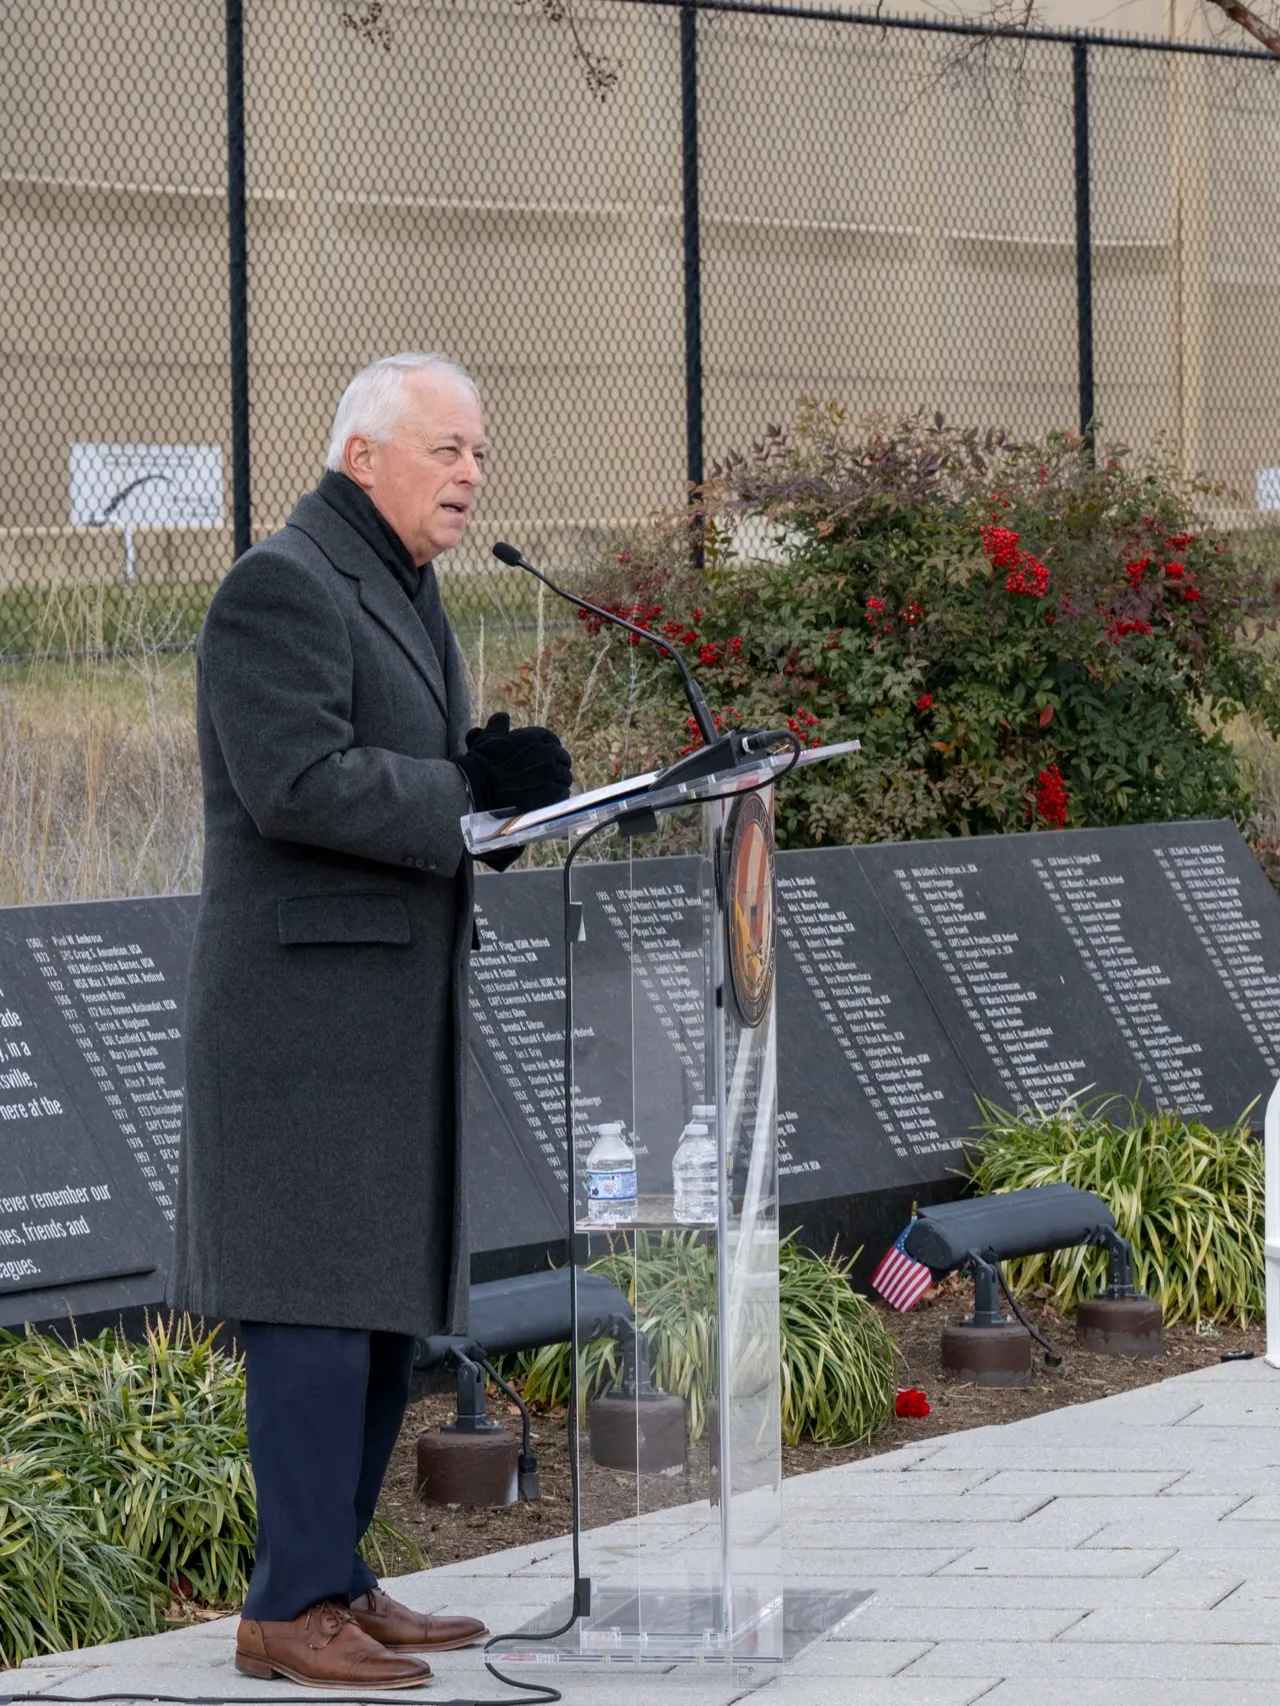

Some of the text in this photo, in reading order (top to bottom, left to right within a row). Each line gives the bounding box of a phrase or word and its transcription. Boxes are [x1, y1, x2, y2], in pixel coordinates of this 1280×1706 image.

[5, 1039, 22, 1059] in
[21, 1041, 31, 1056] a
[28, 1098, 43, 1117] at
[40, 1097, 63, 1115] the
[30, 1184, 89, 1209] remember
[90, 1184, 111, 1201] our
[22, 1218, 67, 1242] friends
[66, 1215, 91, 1236] and
